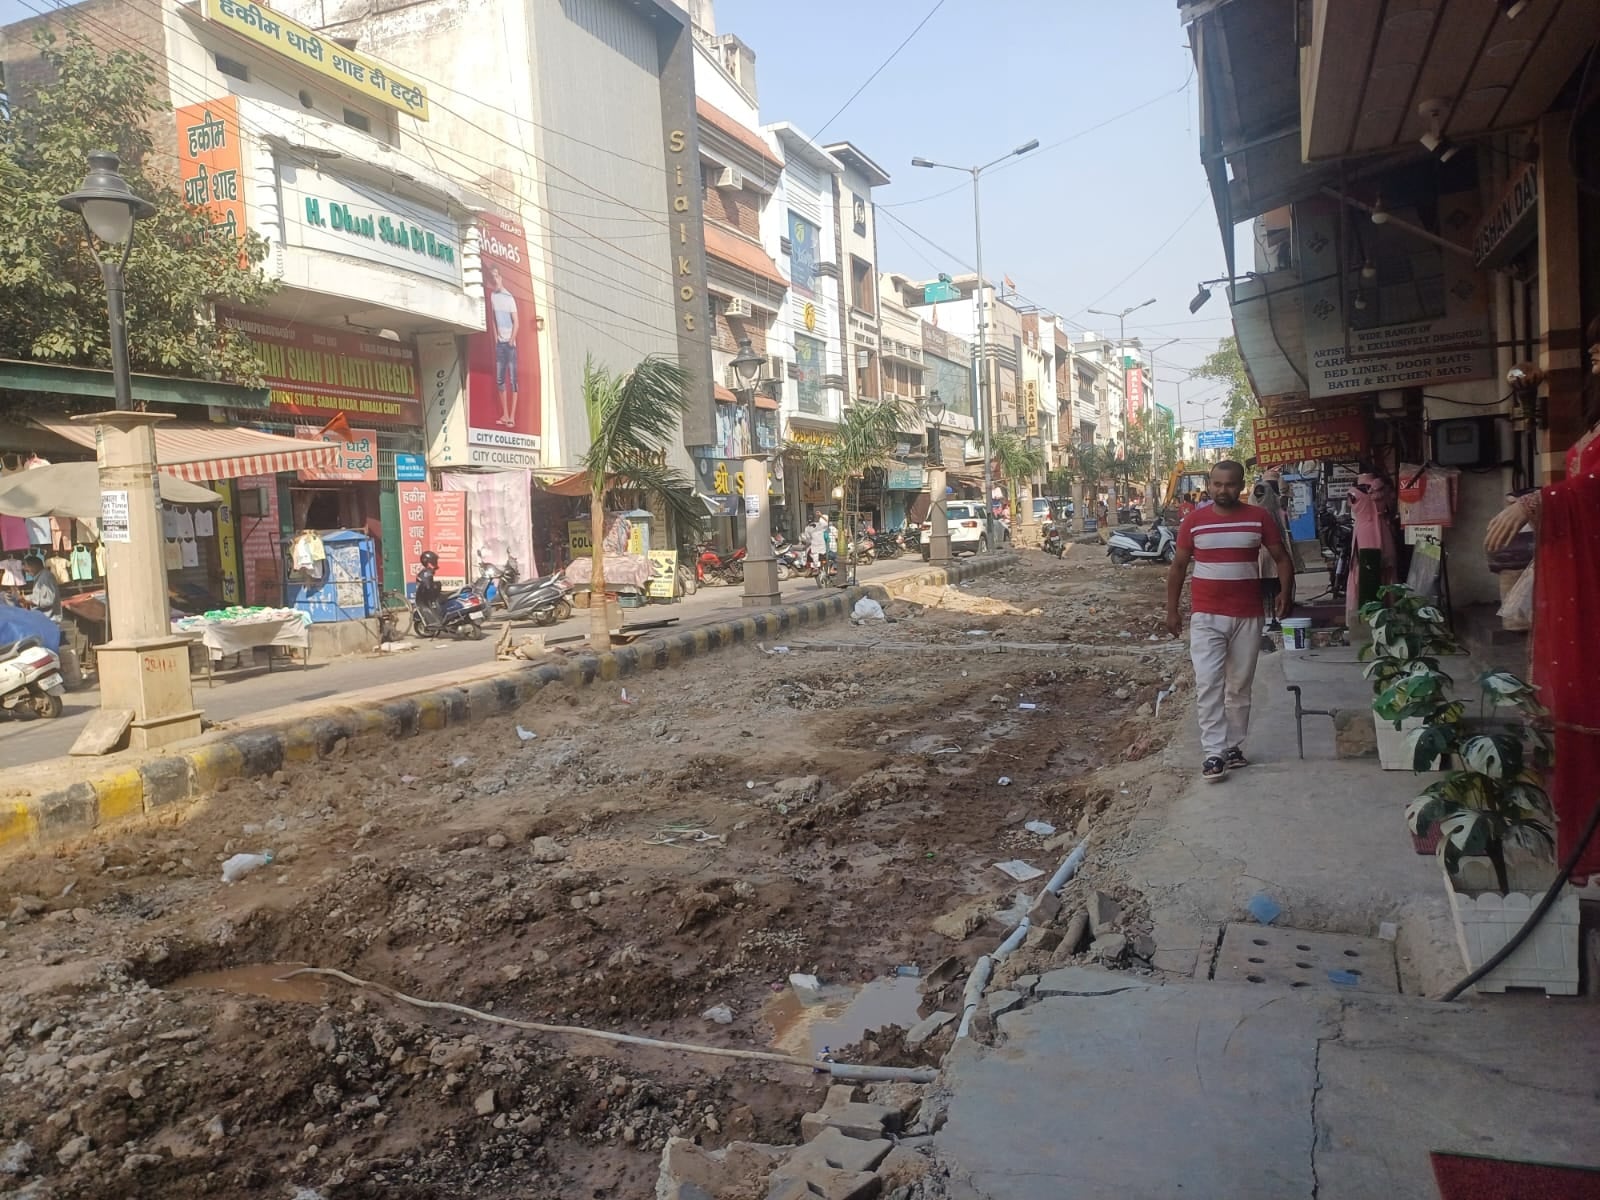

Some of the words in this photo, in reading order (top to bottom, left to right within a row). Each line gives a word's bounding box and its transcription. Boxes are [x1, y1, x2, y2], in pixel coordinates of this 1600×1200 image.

[287, 30, 323, 62] धारी
[333, 54, 365, 82] शाह
[369, 68, 386, 91] दी
[187, 110, 225, 157] हकीम
[185, 164, 209, 205] धारी
[213, 170, 237, 201] शाह
[670, 130, 695, 331] Sialkot
[1324, 367, 1348, 379] BED
[1396, 357, 1432, 370] DOOR
[1328, 378, 1360, 390] BATH
[1364, 377, 1374, 386] &
[1377, 370, 1433, 384] KITCHEN
[1436, 365, 1473, 377] MATS
[1028, 382, 1036, 428] SANGAM
[476, 432, 495, 444] CITY
[496, 434, 536, 448] COLLECTION
[1257, 425, 1316, 440] TOWEL
[473, 450, 491, 462] CITY
[492, 452, 536, 465] COLLECTION
[1260, 449, 1305, 464] BATH
[1311, 442, 1360, 458] GOWN
